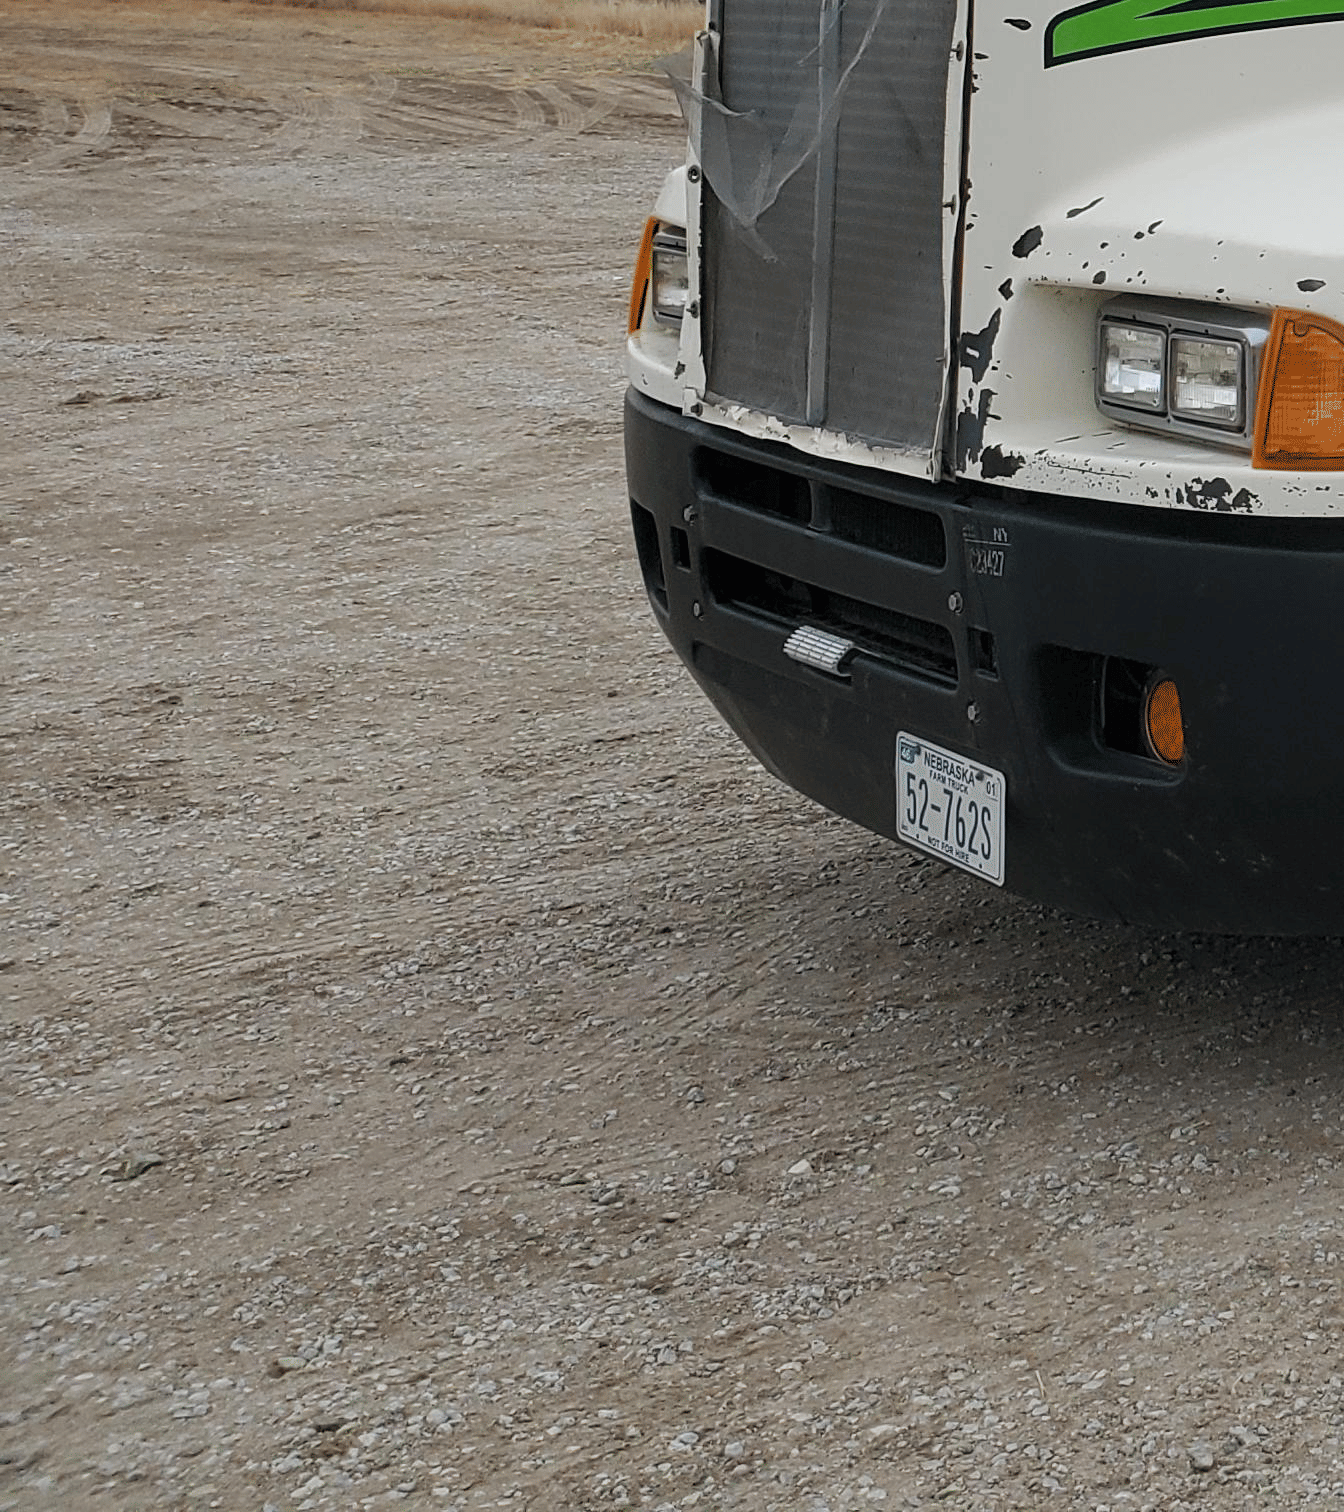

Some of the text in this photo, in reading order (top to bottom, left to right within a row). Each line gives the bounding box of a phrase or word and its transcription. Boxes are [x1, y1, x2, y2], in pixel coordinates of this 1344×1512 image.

[924, 751, 975, 787] NEBRASKA
[929, 769, 969, 795] FARM TRUCK
[906, 772, 992, 860] 52-762S
[927, 835, 970, 863] NOT FOR HIRE
